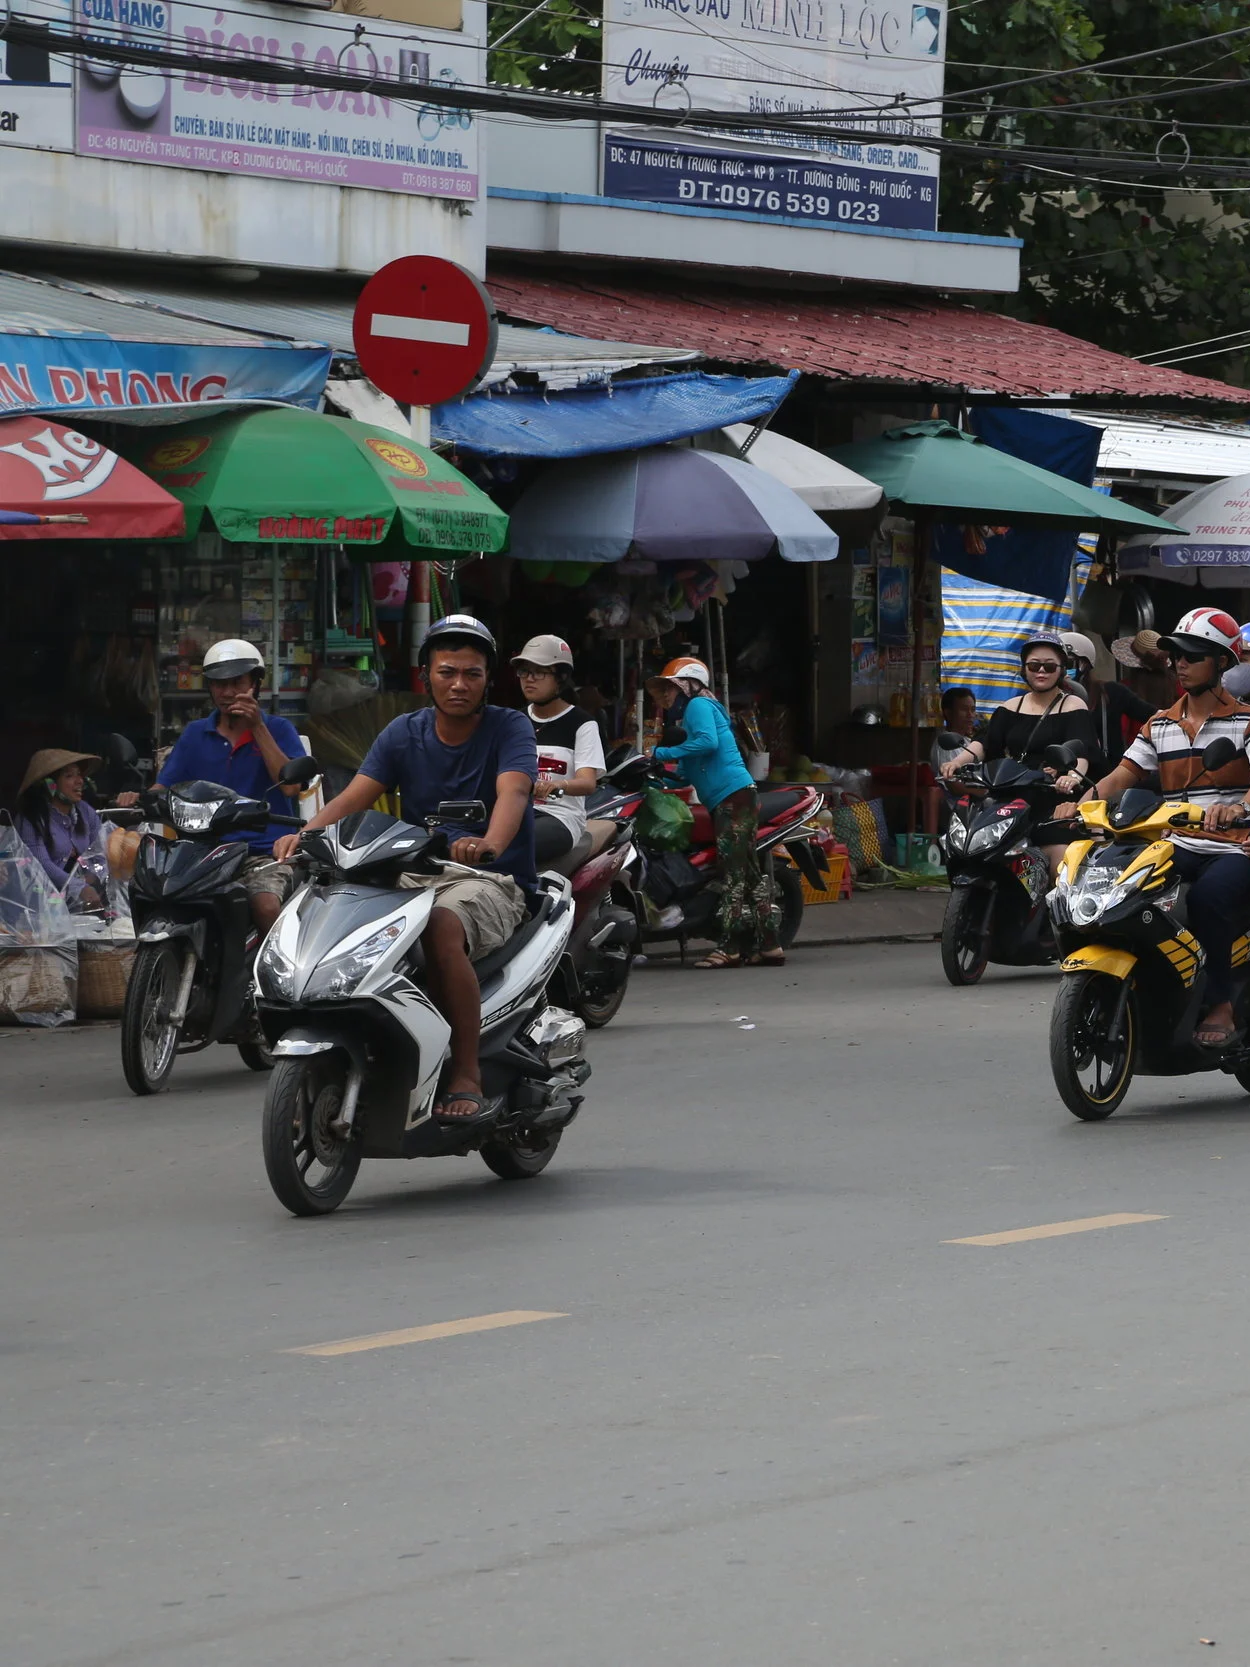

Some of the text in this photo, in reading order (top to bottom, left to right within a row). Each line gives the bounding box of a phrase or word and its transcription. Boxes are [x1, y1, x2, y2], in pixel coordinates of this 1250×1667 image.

[291, 42, 393, 119] LOAN
[174, 114, 207, 136] CHUYÊN:
[105, 136, 118, 150] 48
[119, 134, 158, 154] NGUYỄN
[160, 142, 191, 159] TRUNG
[305, 158, 322, 175] PHÚ
[416, 174, 437, 189] 0918
[439, 177, 453, 191] 387
[456, 179, 471, 193] 660
[867, 145, 896, 169] ORDER,
[611, 146, 932, 202] ĐC: 47 NGUYỄN TRUNG TRỰC KP 8 TT. DƯƠNG ĐÔNG PHÚ QUỐC KG
[786, 192, 830, 216] 539
[838, 199, 880, 222] 023
[47, 365, 228, 405] PHONG
[258, 511, 328, 540] HOÀNG
[333, 512, 388, 541] PHÁT
[475, 532, 492, 548] 079
[1195, 525, 1237, 535] TRUNG
[1193, 550, 1222, 563] 0297
[1225, 550, 1250, 563] 3830
